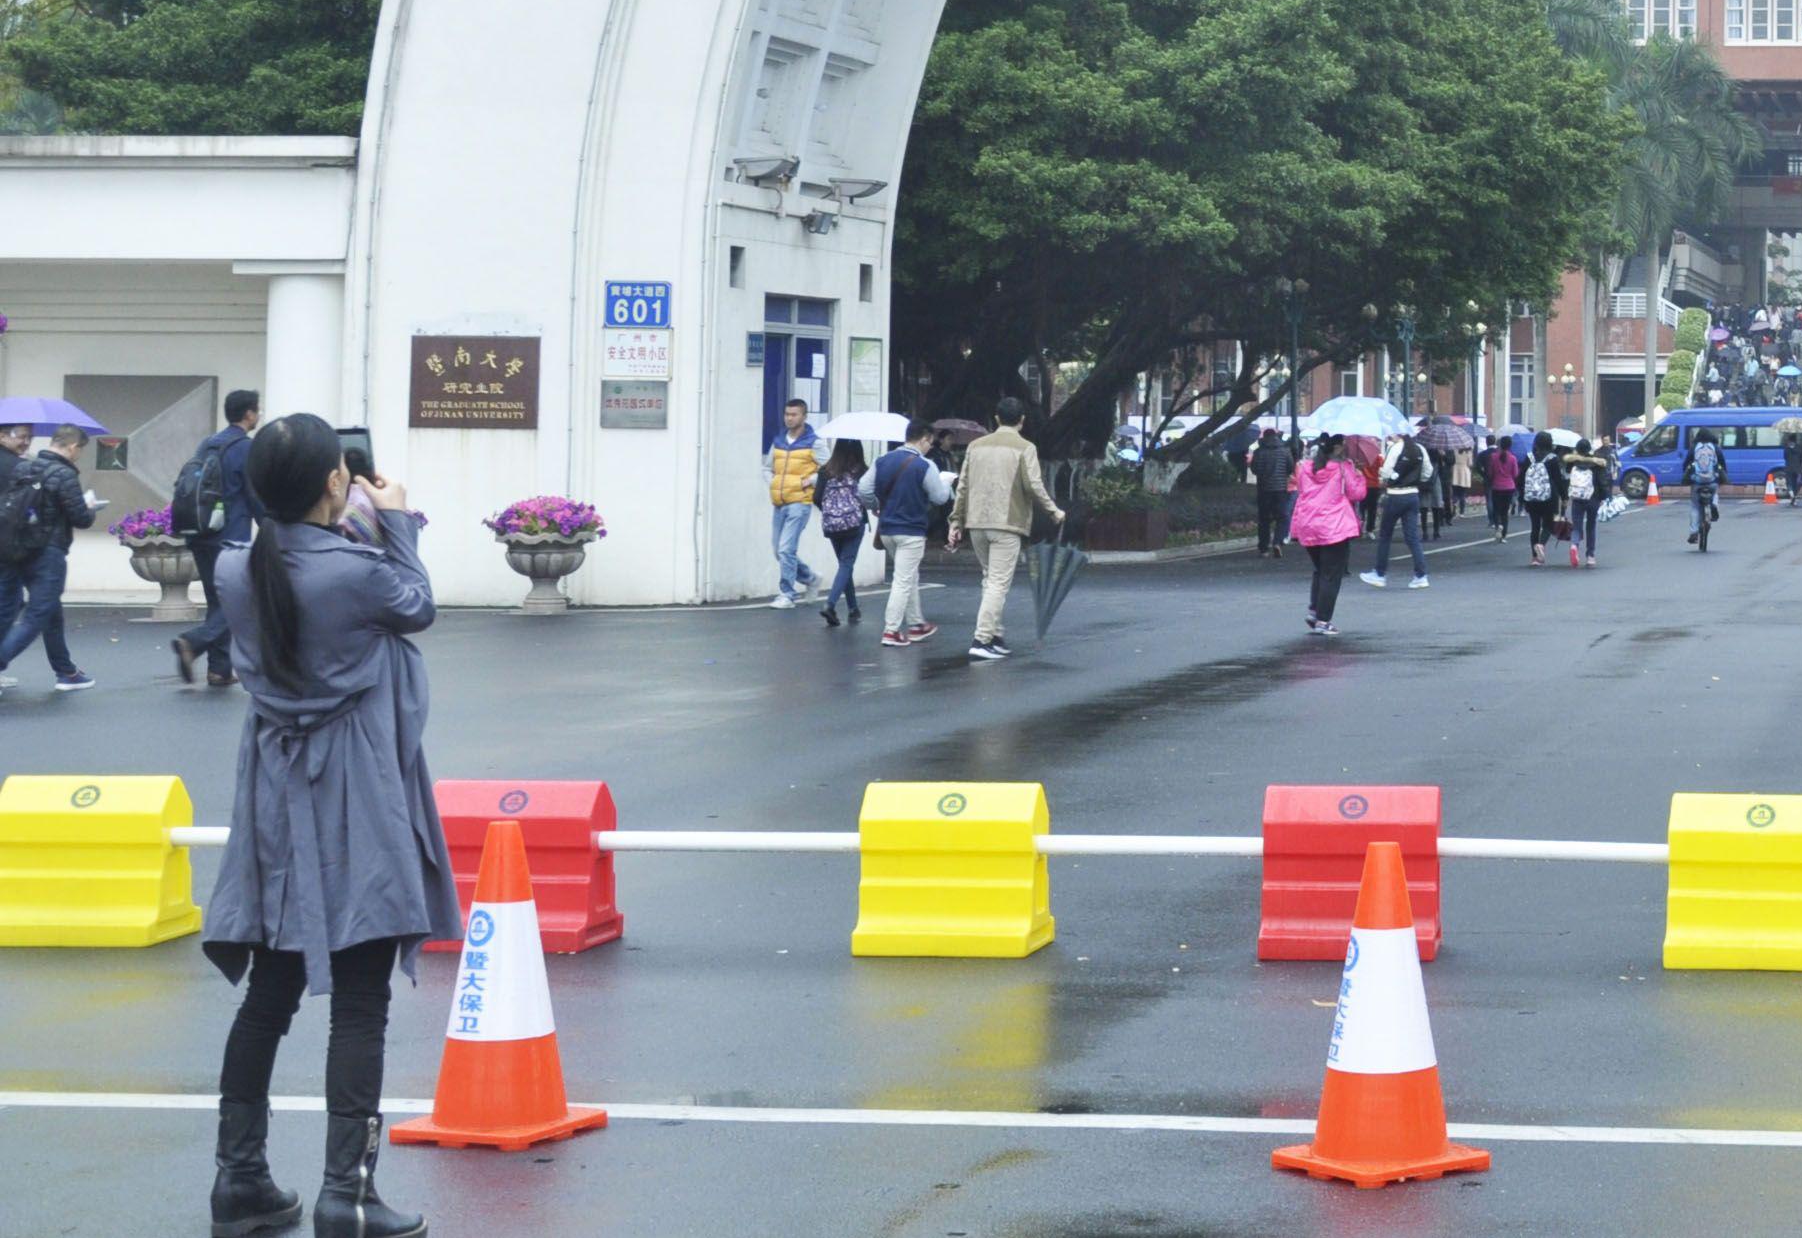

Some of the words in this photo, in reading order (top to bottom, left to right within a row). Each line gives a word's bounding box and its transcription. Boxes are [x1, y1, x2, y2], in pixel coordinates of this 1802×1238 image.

[613, 298, 662, 324] 601
[607, 345, 667, 361] 安全文明小区
[442, 382, 505, 395] 研究生院
[421, 400, 439, 409] THE
[440, 400, 488, 409] GRADUATE
[489, 401, 526, 410] SCHOOL
[420, 410, 432, 419] OF
[433, 410, 464, 419] JINAN
[465, 410, 525, 420] UNIVERSITY
[456, 950, 490, 1034] 暨大保卫
